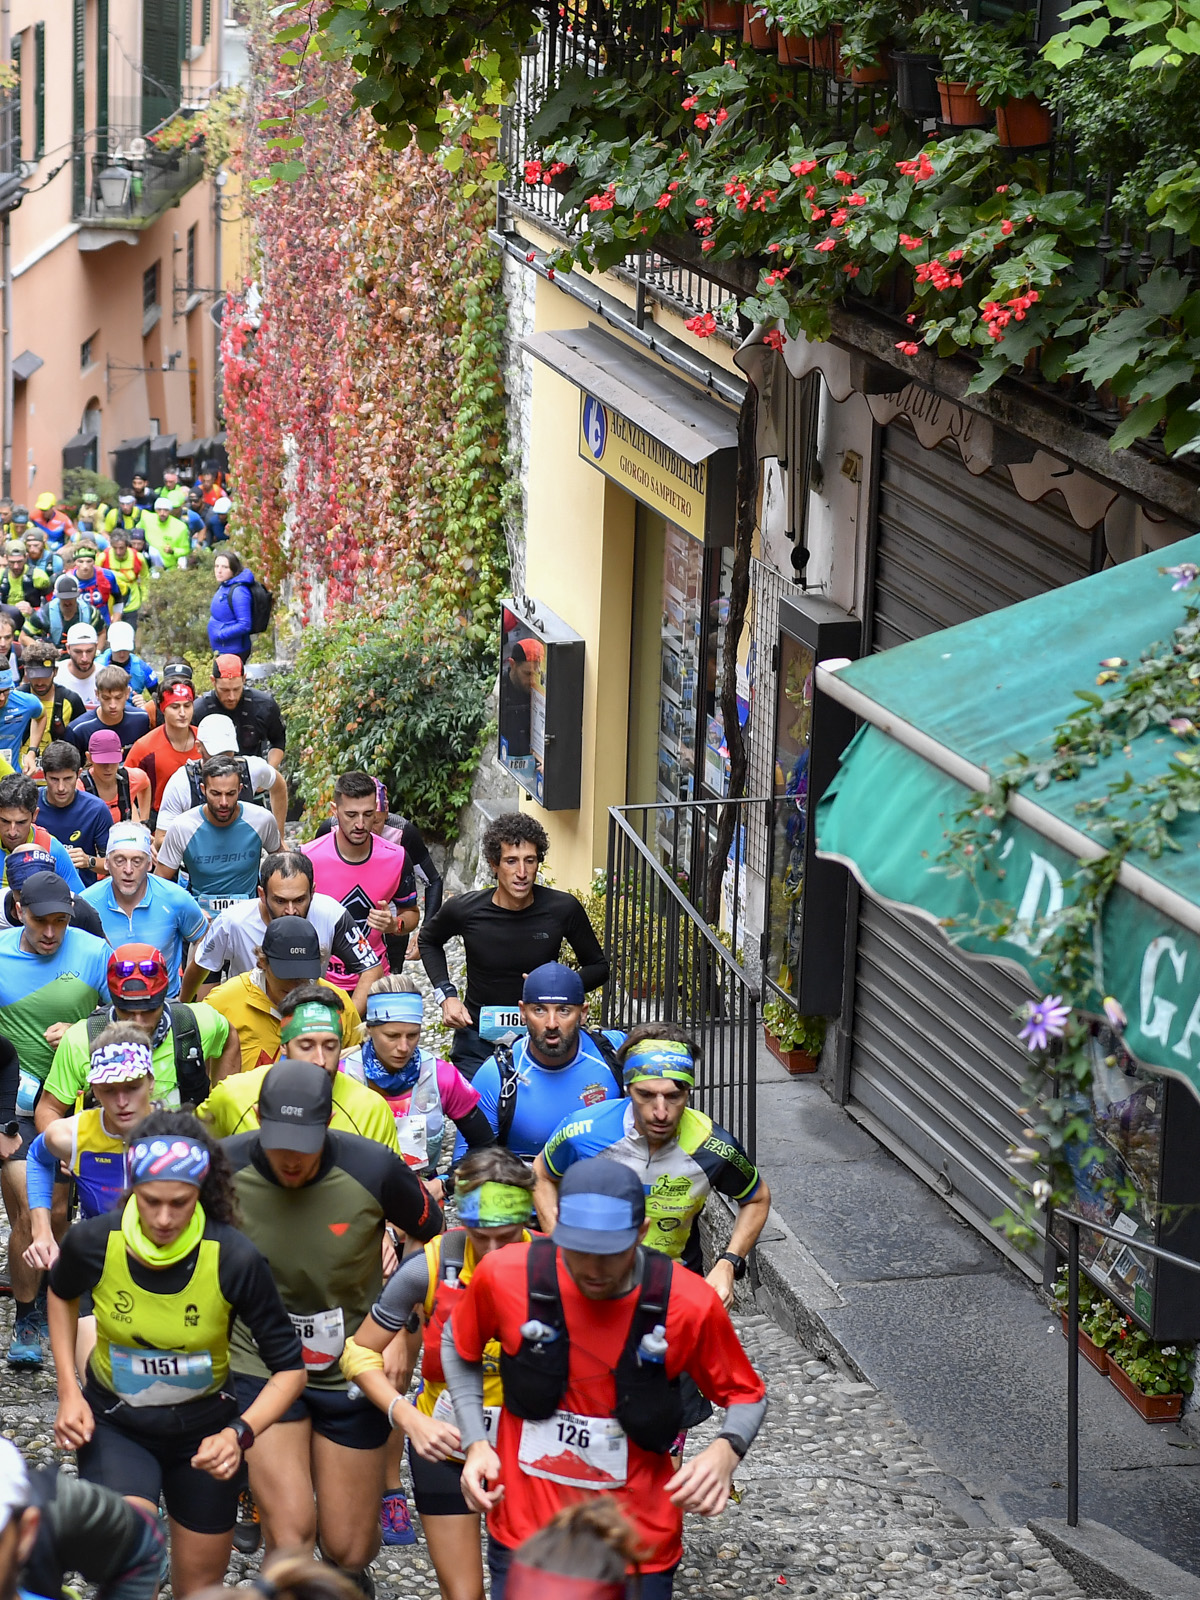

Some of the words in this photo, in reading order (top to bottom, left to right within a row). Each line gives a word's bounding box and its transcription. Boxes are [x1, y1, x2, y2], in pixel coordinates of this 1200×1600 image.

[611, 412, 646, 457] AGENZIA
[648, 438, 706, 495] IMMOBILIARE
[620, 455, 650, 488] GIORGIO
[651, 476, 692, 517] SAMPIETRO
[290, 947, 306, 955] GORE
[280, 1105, 304, 1118] GORE
[110, 1311, 133, 1325] GEFO
[140, 1357, 179, 1376] 1151
[557, 1423, 591, 1449] 126
